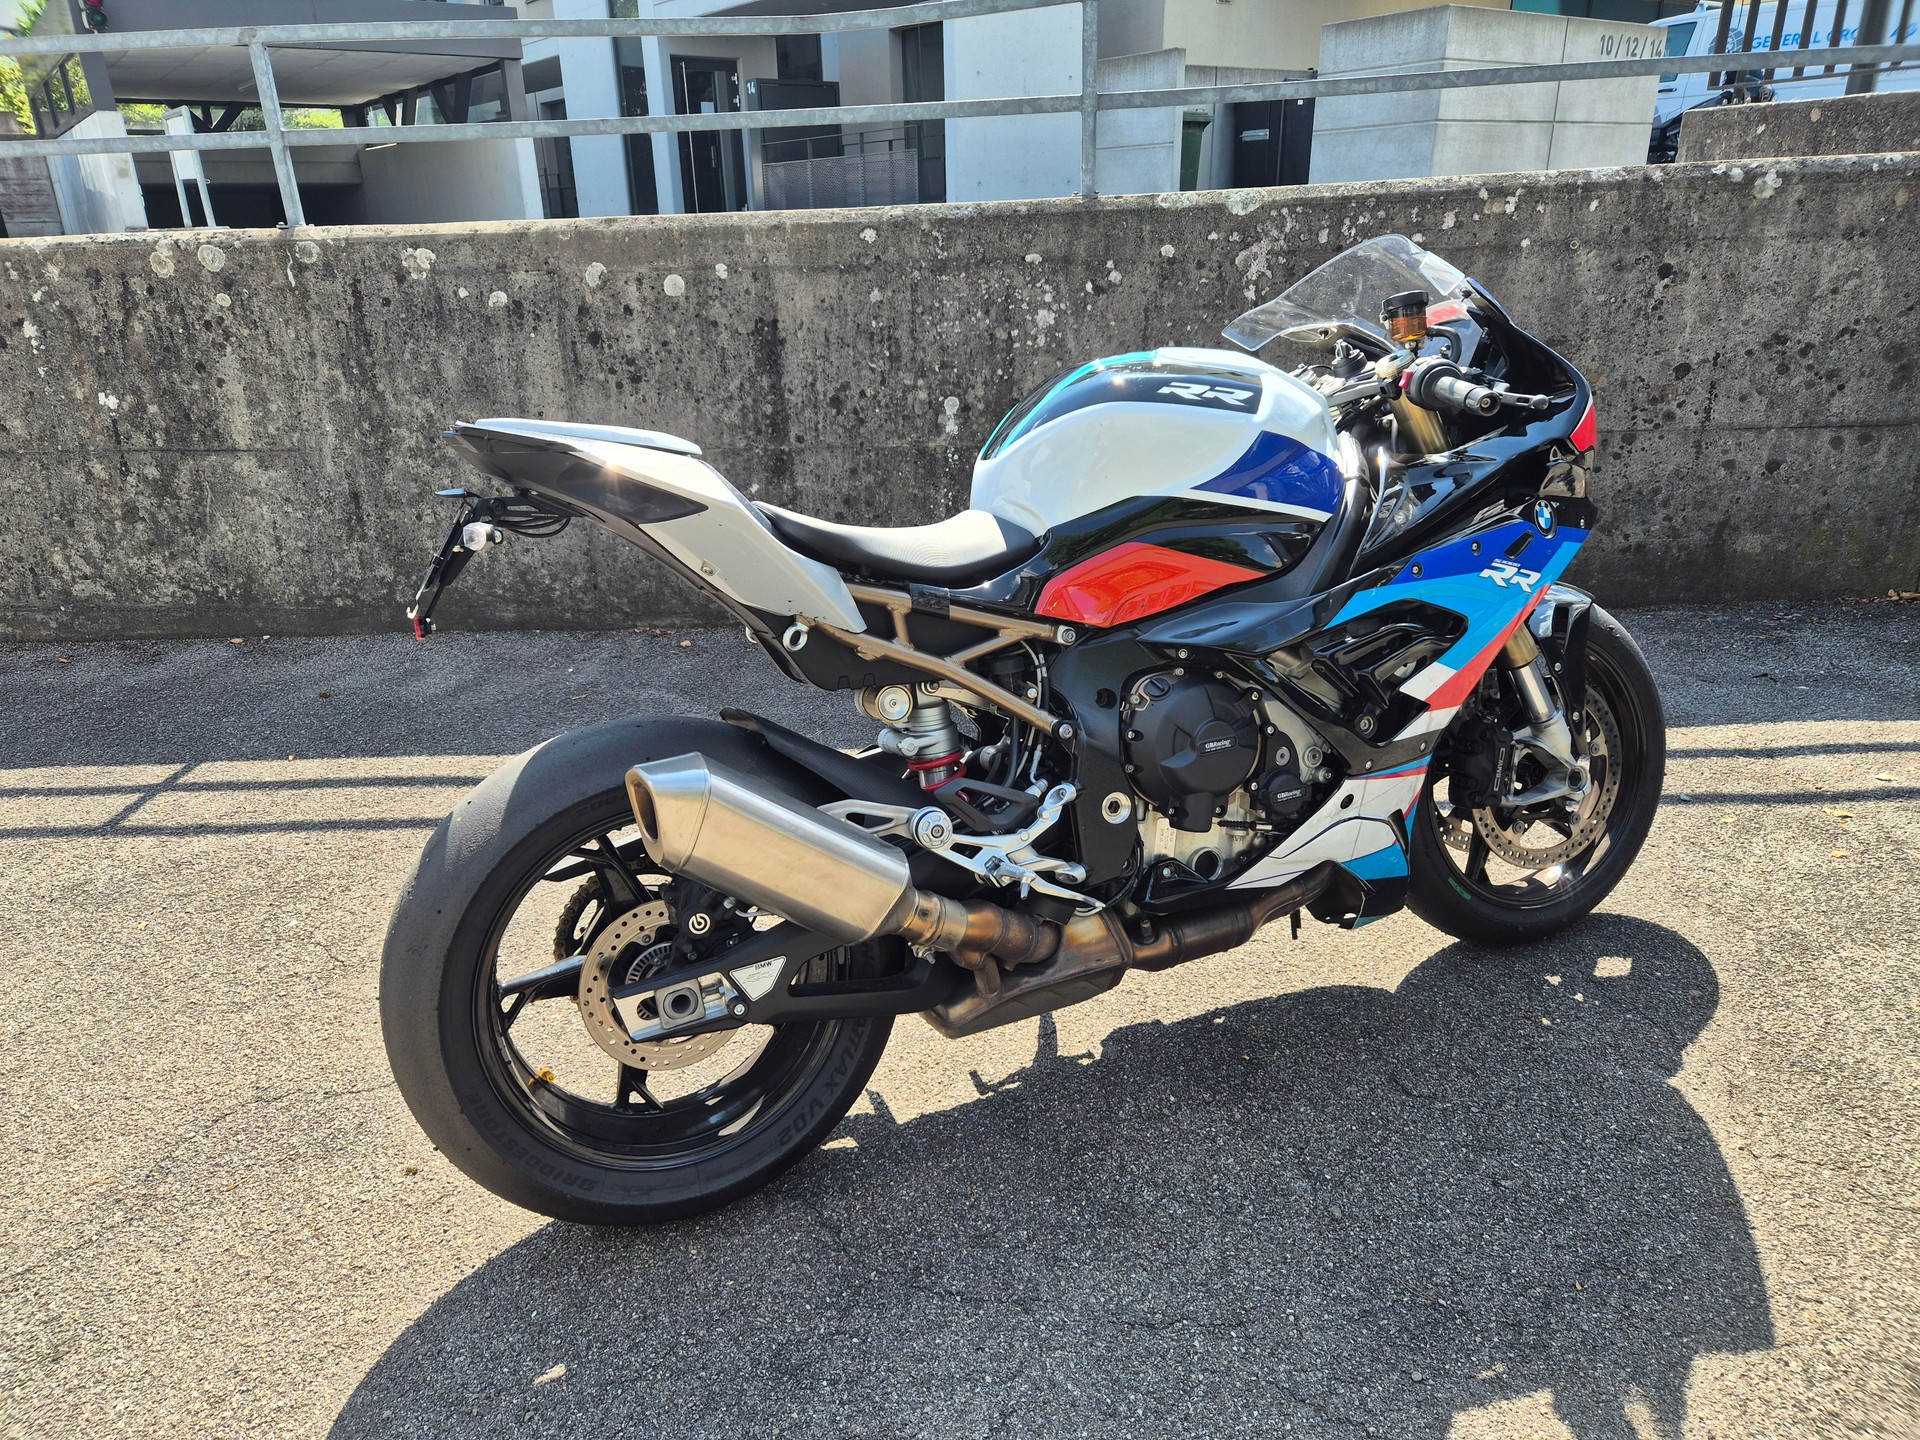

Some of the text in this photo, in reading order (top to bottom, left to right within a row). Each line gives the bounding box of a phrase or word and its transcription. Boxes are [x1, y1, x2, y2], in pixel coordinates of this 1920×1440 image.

[1600, 33, 1662, 58] 10/12/14
[1752, 31, 1822, 49] GEERL
[1157, 382, 1254, 407] RR
[1478, 562, 1542, 594] RR
[754, 960, 773, 970] BMW
[824, 1016, 867, 1096] ATTLAX
